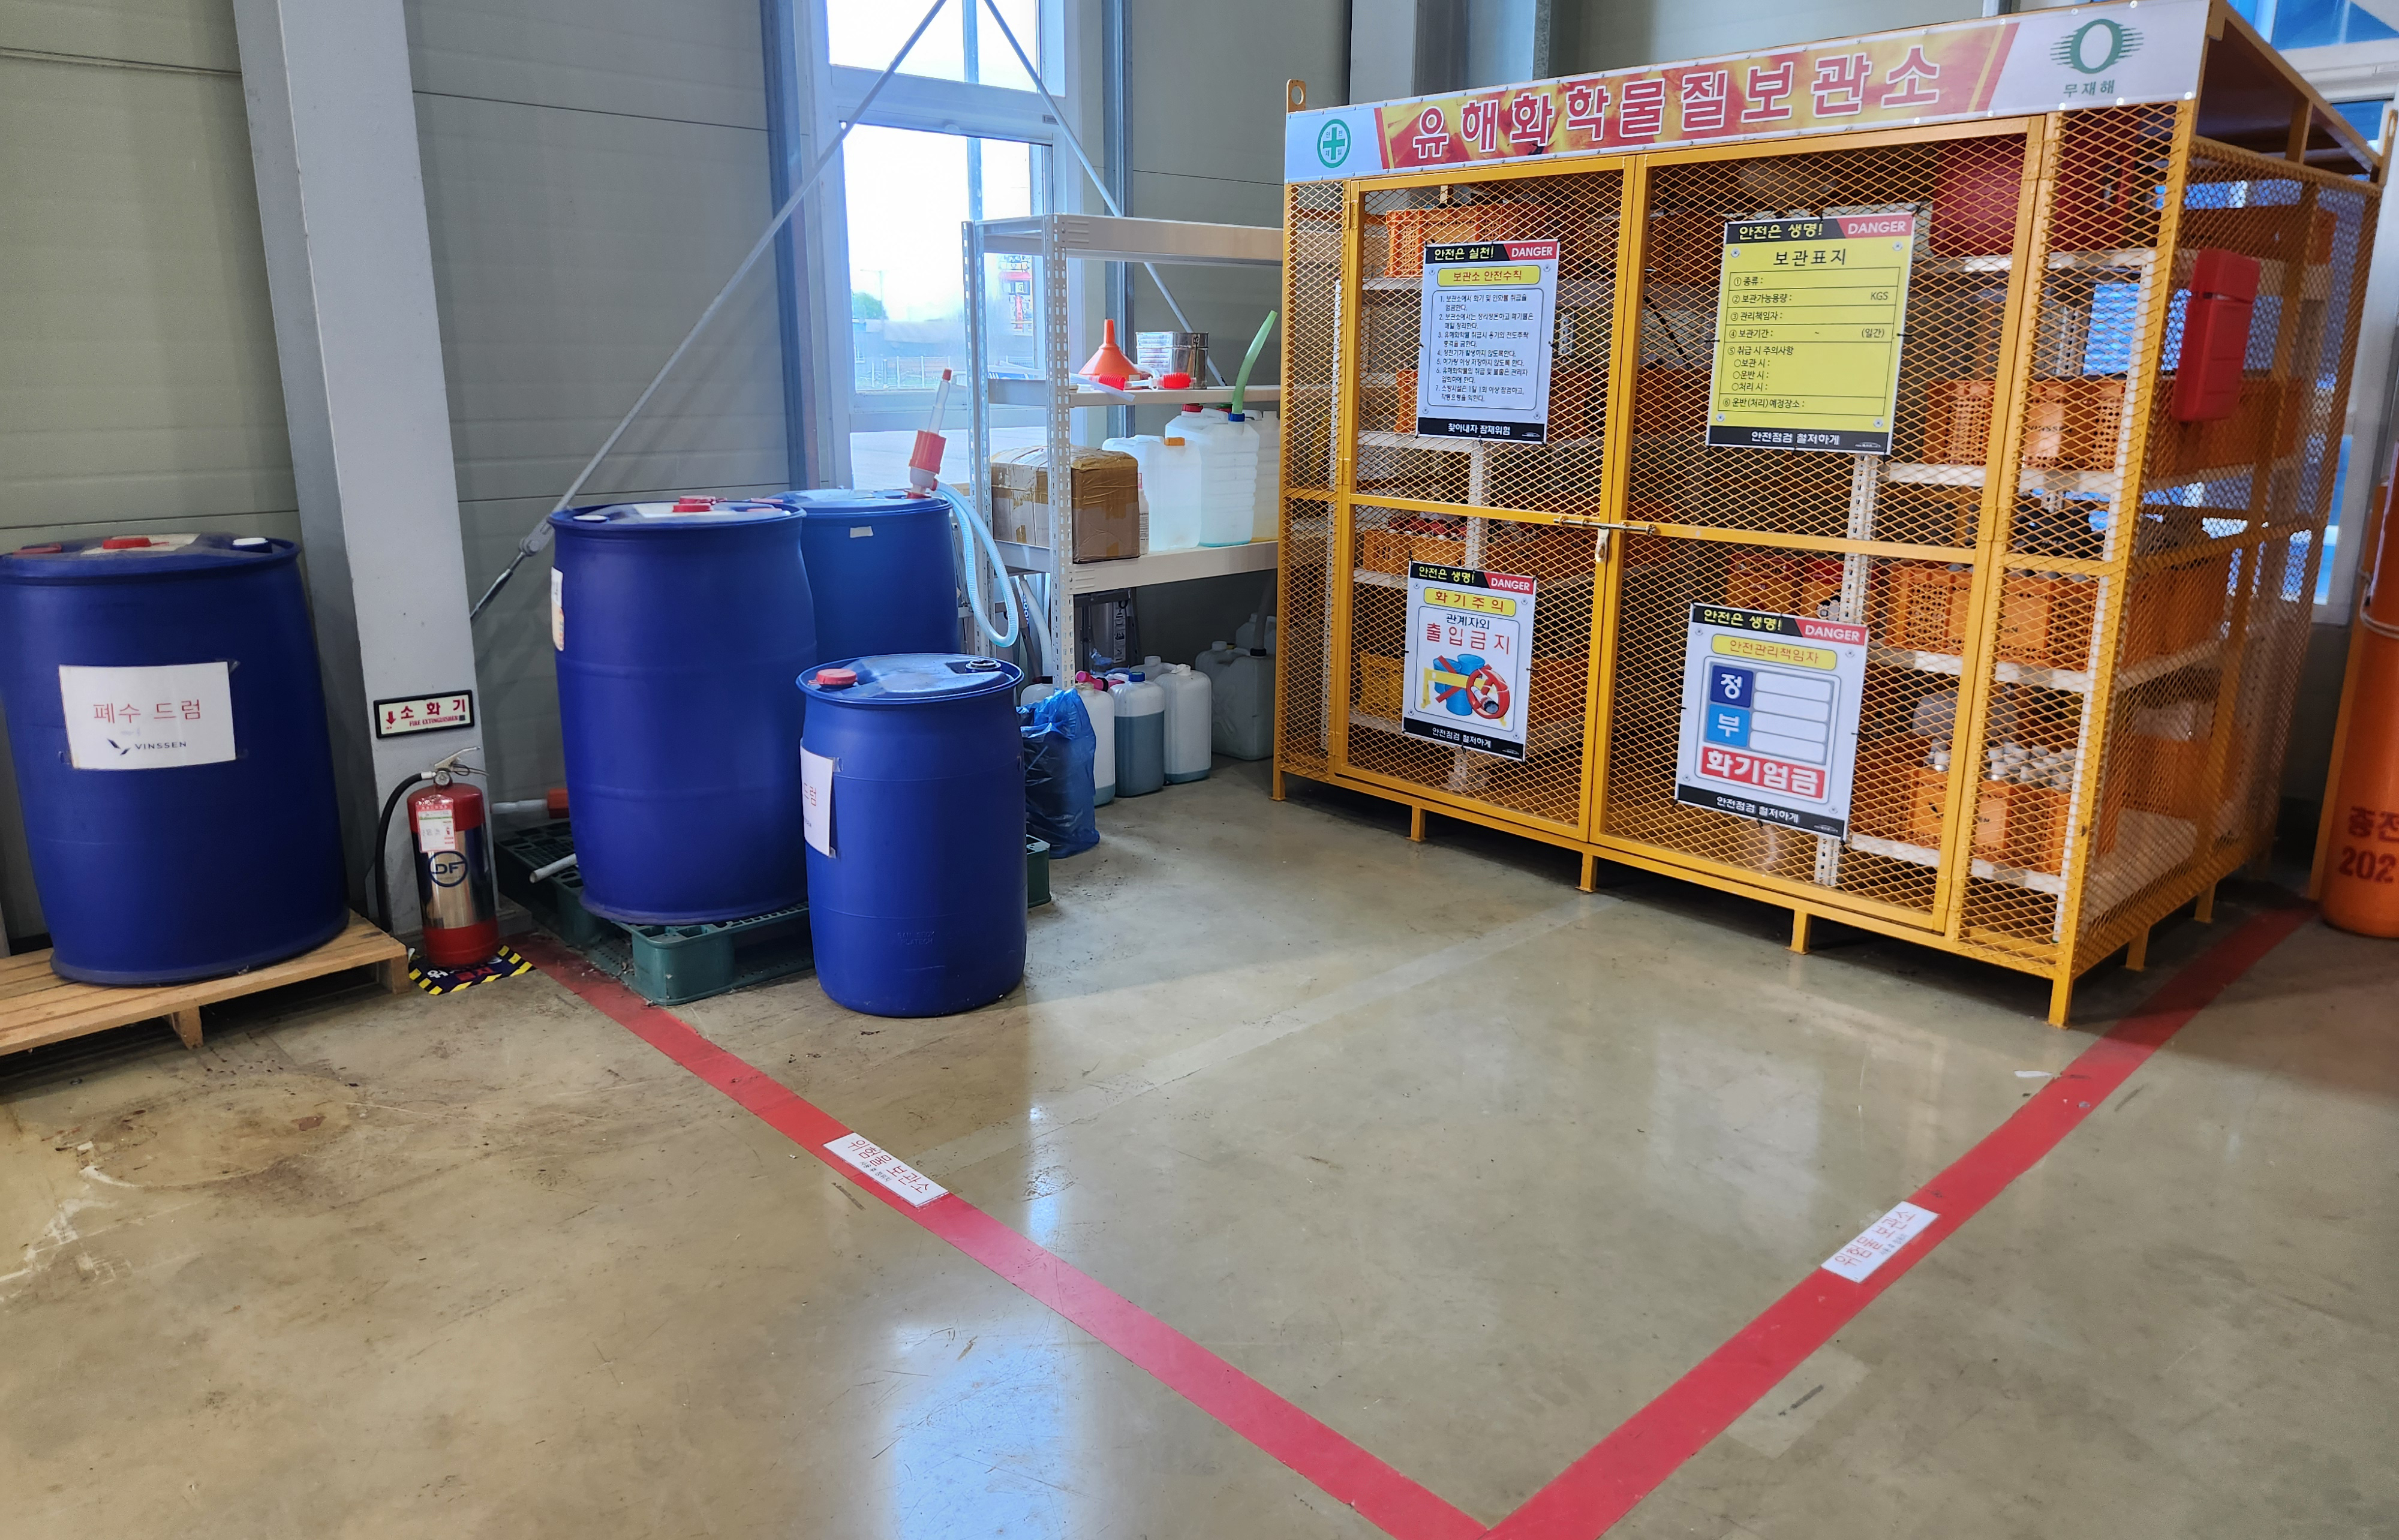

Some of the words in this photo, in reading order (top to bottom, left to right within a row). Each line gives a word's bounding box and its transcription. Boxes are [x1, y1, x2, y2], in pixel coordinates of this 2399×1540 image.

[2063, 79, 2115, 98] 무재해
[1412, 46, 1940, 160] 유해화학물질보관소
[1739, 225, 1782, 240] 안전은
[1788, 222, 1823, 237] 생명!
[1848, 221, 1906, 235] DANGER
[1434, 248, 1465, 261] 안전은
[1469, 246, 1494, 259] 실천!
[1511, 246, 1553, 257] DANGER
[1773, 248, 1847, 267] 보관표지
[1453, 272, 1480, 282] 보관소
[1484, 270, 1522, 281] 안전수칙
[1446, 294, 1472, 303] 보관소에서
[1871, 291, 1889, 300] KGS
[1478, 312, 1510, 321] 정리정돈하고
[1861, 328, 1884, 339] (일간)
[1737, 346, 1752, 355] 취급
[1754, 346, 1761, 355] 시
[1763, 346, 1794, 355] 주의사항
[1448, 423, 1478, 434] 찾아내자
[1480, 425, 1511, 435] 잠재위험
[1751, 431, 1793, 444] 안전점검
[1796, 432, 1840, 446] 철저하게
[1418, 566, 1447, 580] 안전은
[1451, 570, 1475, 583] 생명!
[1491, 578, 1530, 591] DANGER
[1435, 591, 1504, 612] 화기주의
[1445, 613, 1490, 630] 관계자외
[1704, 609, 1743, 627] 안전은
[1749, 615, 1782, 631] 생명!
[1426, 622, 1510, 655] 출입금지
[1805, 625, 1860, 642] DANGER
[1730, 640, 1818, 664] 안전관리책임자
[1720, 673, 1742, 699] 정
[94, 703, 141, 724] 폐수
[154, 699, 200, 720] 드럼
[401, 699, 465, 720] 소화기
[422, 715, 458, 726] EXTINGUISHER
[1717, 714, 1739, 737] 부
[135, 741, 187, 750] VINSSEN
[1432, 727, 1460, 741] 안전점검
[1462, 734, 1492, 749] 철저하게
[1706, 750, 1818, 796] 화기엄금
[1716, 796, 1755, 814] 안전점검
[1758, 805, 1799, 823] 철저하게
[432, 861, 465, 874] DF
[847, 1140, 892, 1166] 위험물
[886, 1165, 929, 1193] 보관소
[1835, 1237, 1883, 1266] 위험물
[1872, 1211, 1916, 1238] 보관소
